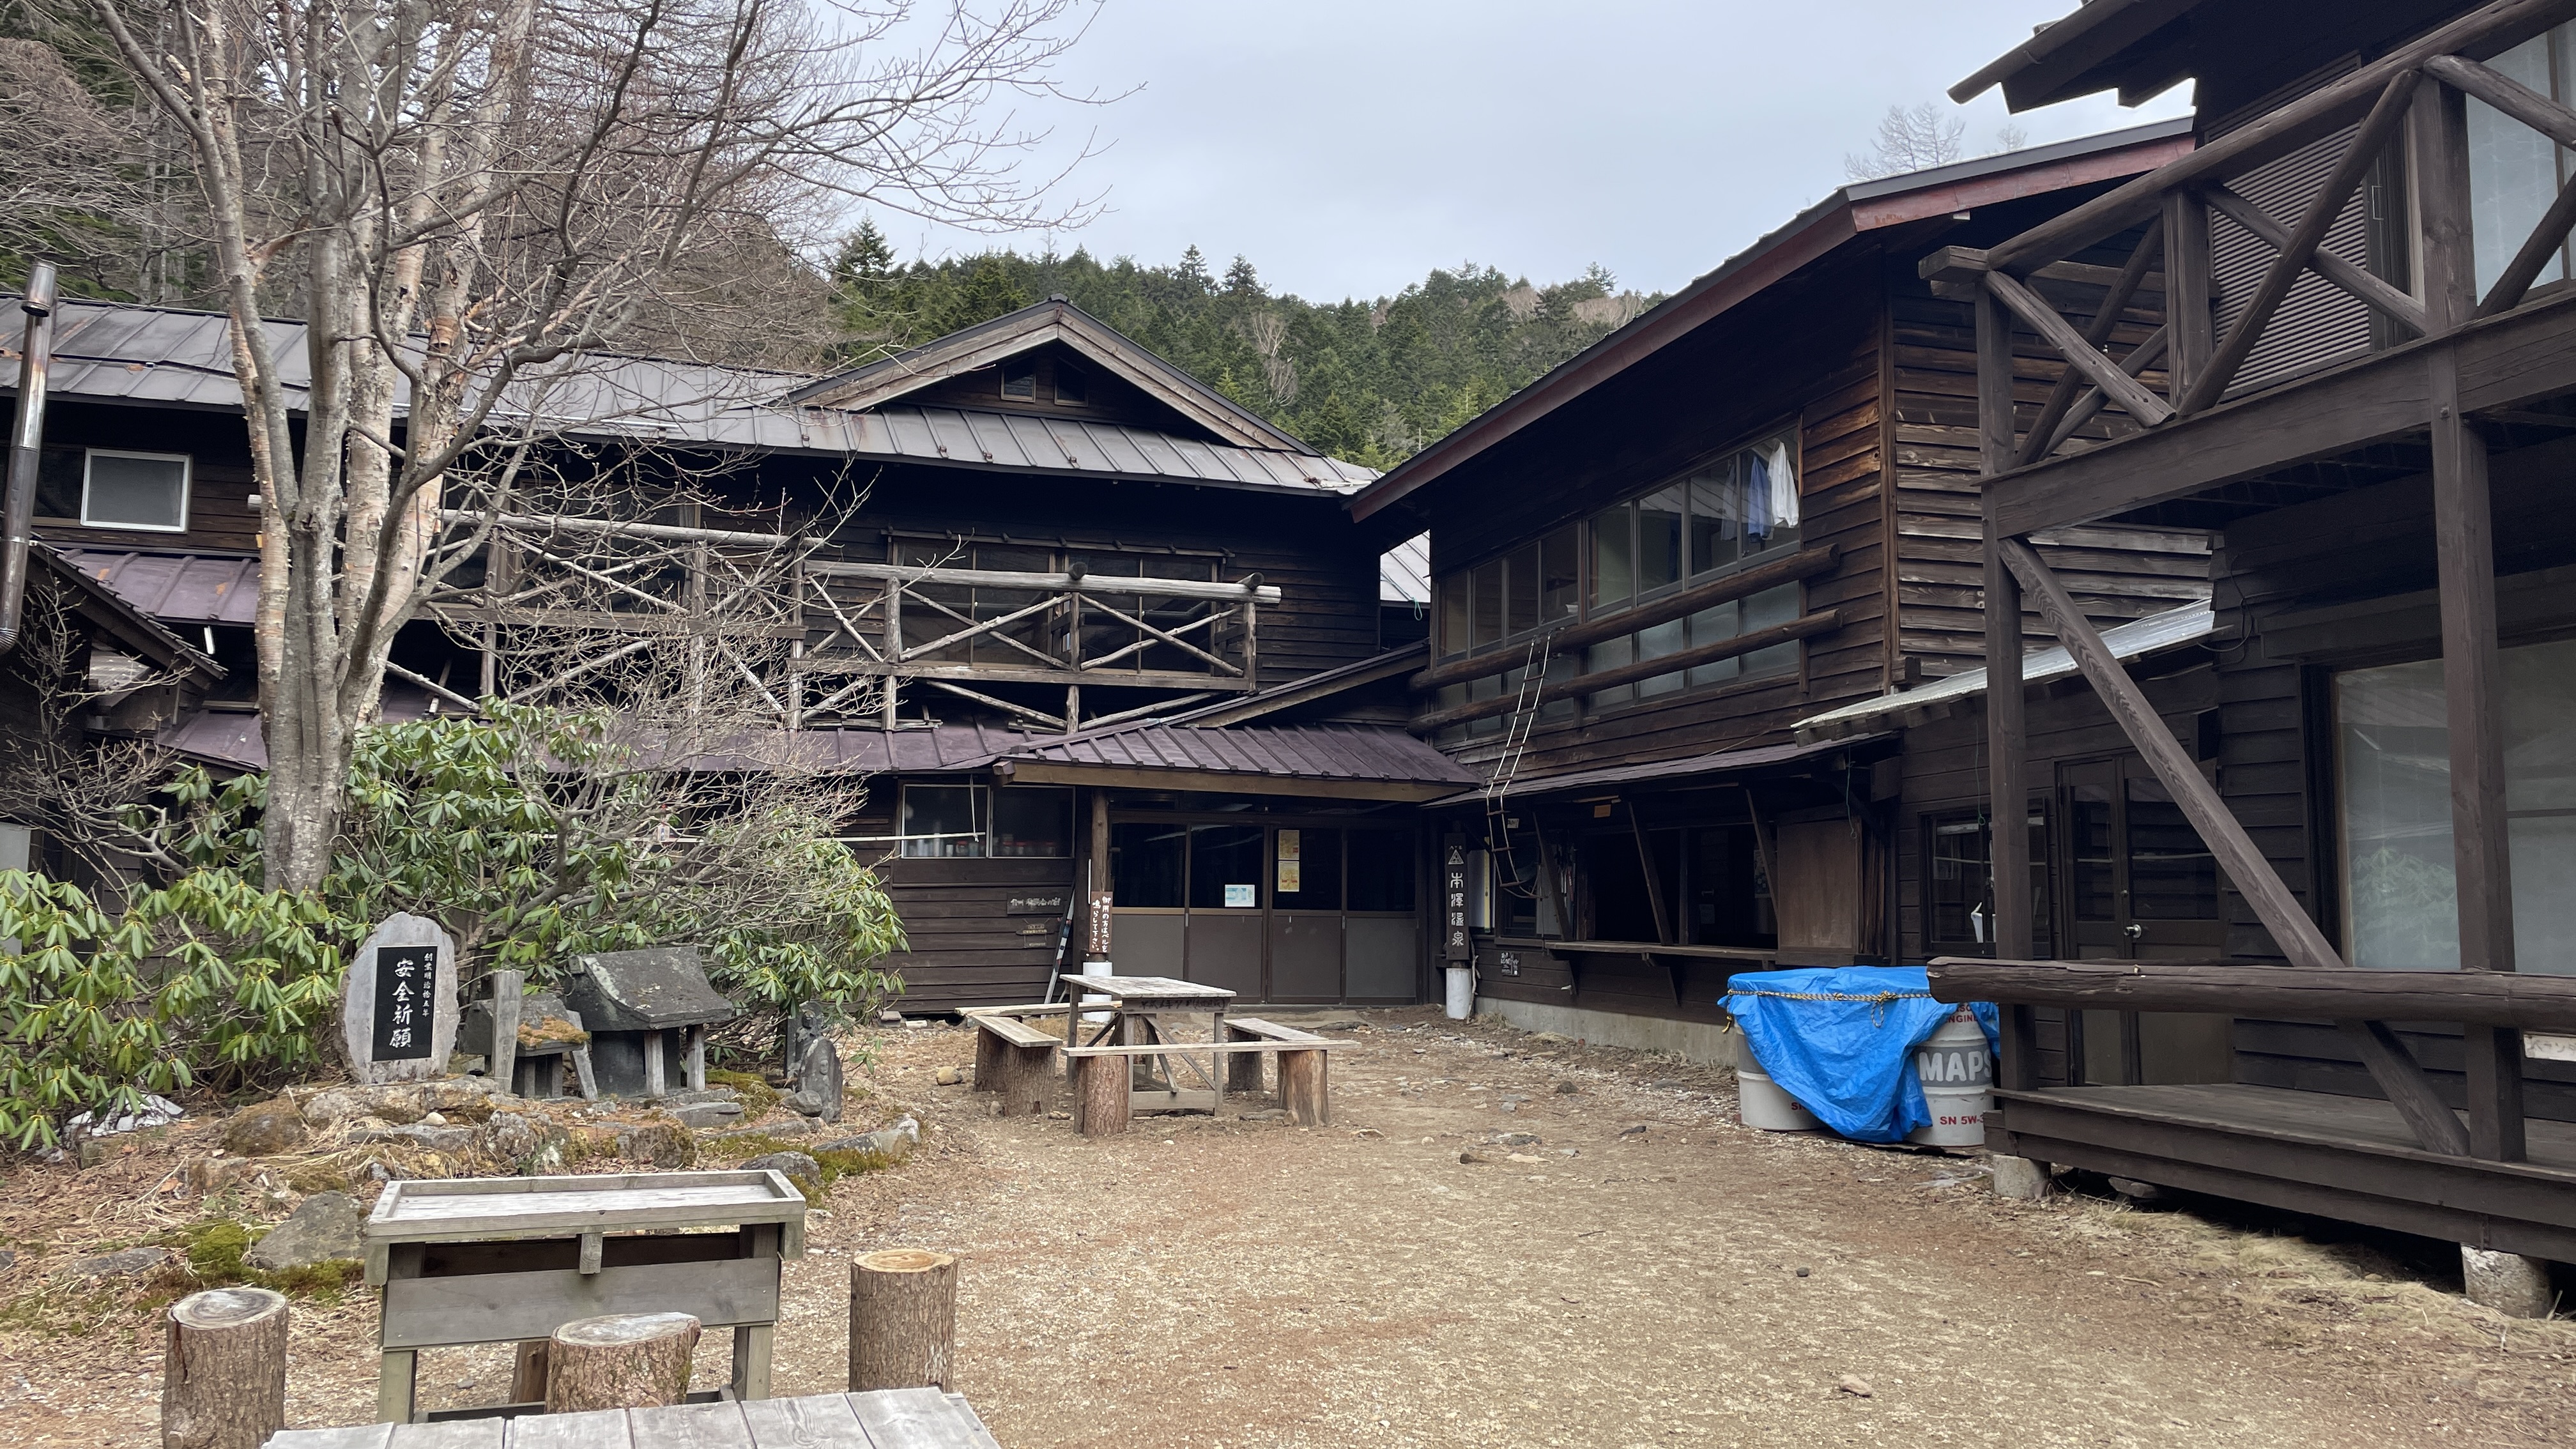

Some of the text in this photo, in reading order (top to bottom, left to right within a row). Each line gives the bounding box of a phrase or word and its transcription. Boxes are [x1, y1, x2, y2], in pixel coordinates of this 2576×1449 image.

[1101, 896, 1112, 953] 御用の方はベルを
[388, 957, 415, 1048] 安全祈願
[1947, 1014, 1979, 1023] NGIN
[1919, 1050, 1992, 1082] MAPS
[1940, 1116, 1957, 1125] SN
